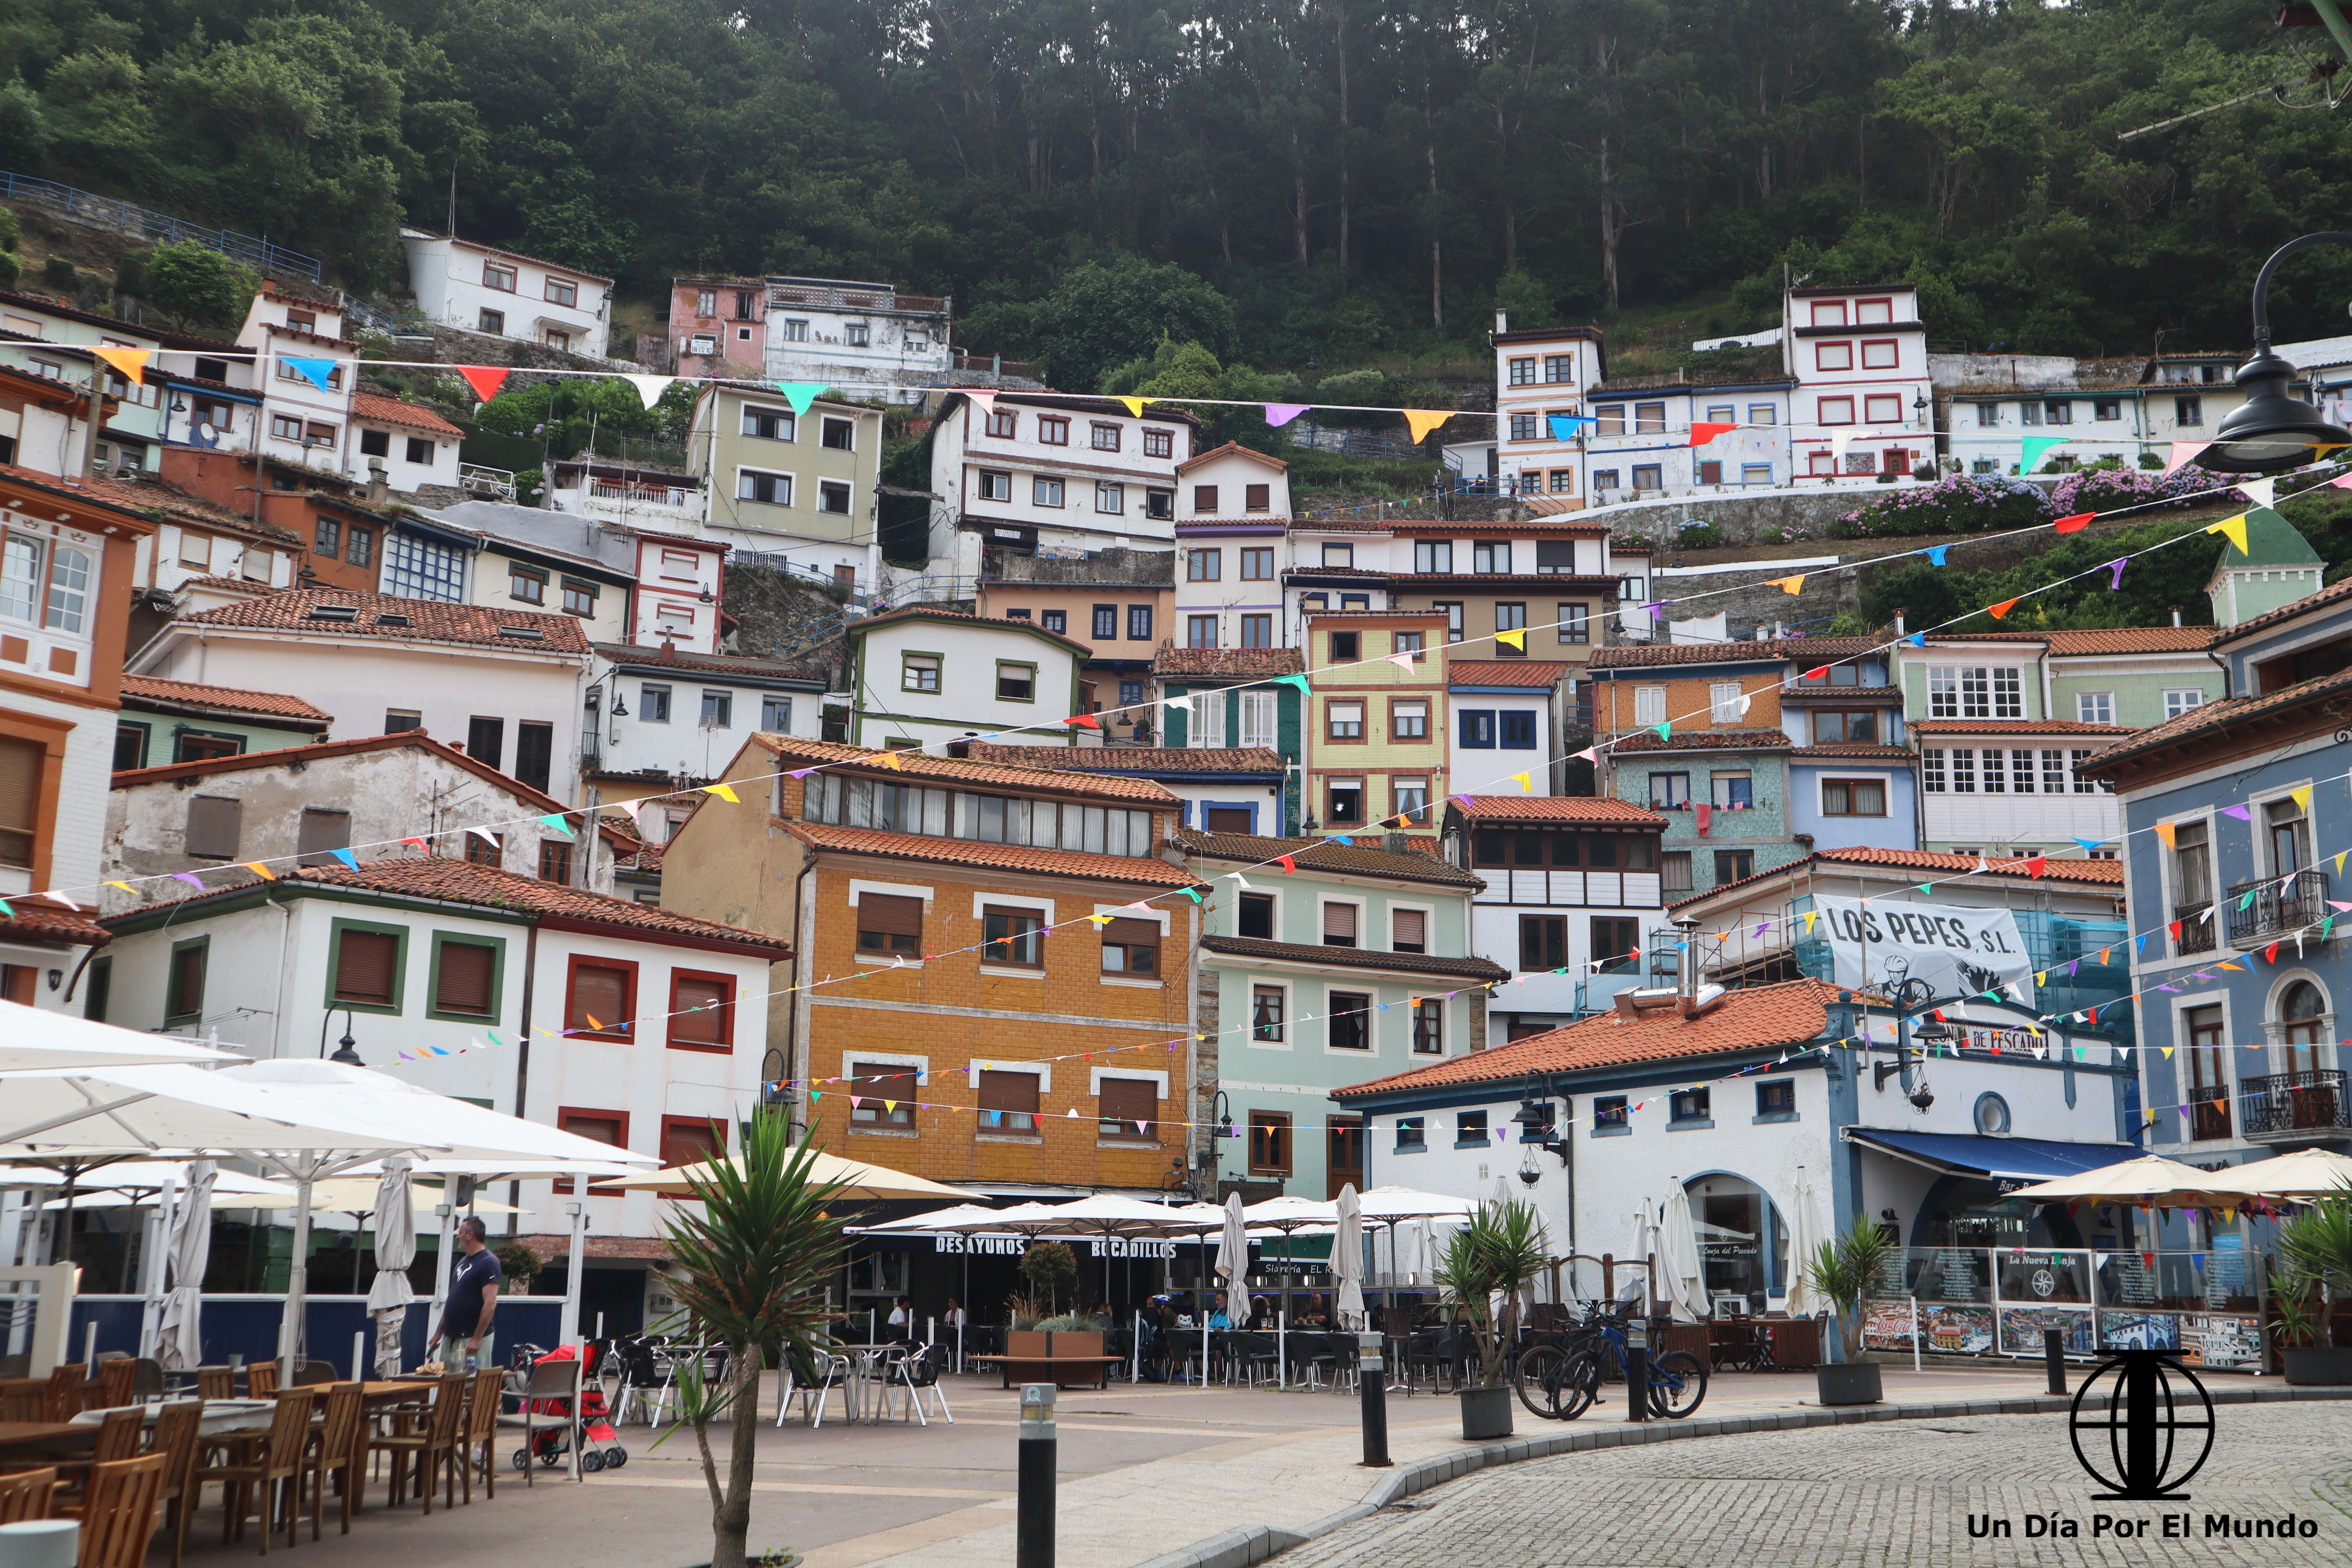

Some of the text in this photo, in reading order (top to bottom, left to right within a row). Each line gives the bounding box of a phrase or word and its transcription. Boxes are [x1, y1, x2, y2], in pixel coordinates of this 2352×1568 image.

[1827, 908, 1883, 943] LOS
[1981, 930, 2016, 953] S.L.
[1973, 1031, 1986, 1047] DE
[1991, 1031, 2043, 1052] PESCADO
[1998, 1180, 2015, 1191] Bar
[936, 1237, 1025, 1255] DESAYUNOS
[1092, 1242, 1176, 1258] BOCADILLOS
[1702, 1246, 1720, 1256] Lonja
[1733, 1246, 1757, 1254] Pescado
[2009, 1256, 2076, 1267] La Nueva Lnja
[1310, 1265, 1322, 1274] EL
[2202, 1340, 2239, 1351] BLISS
